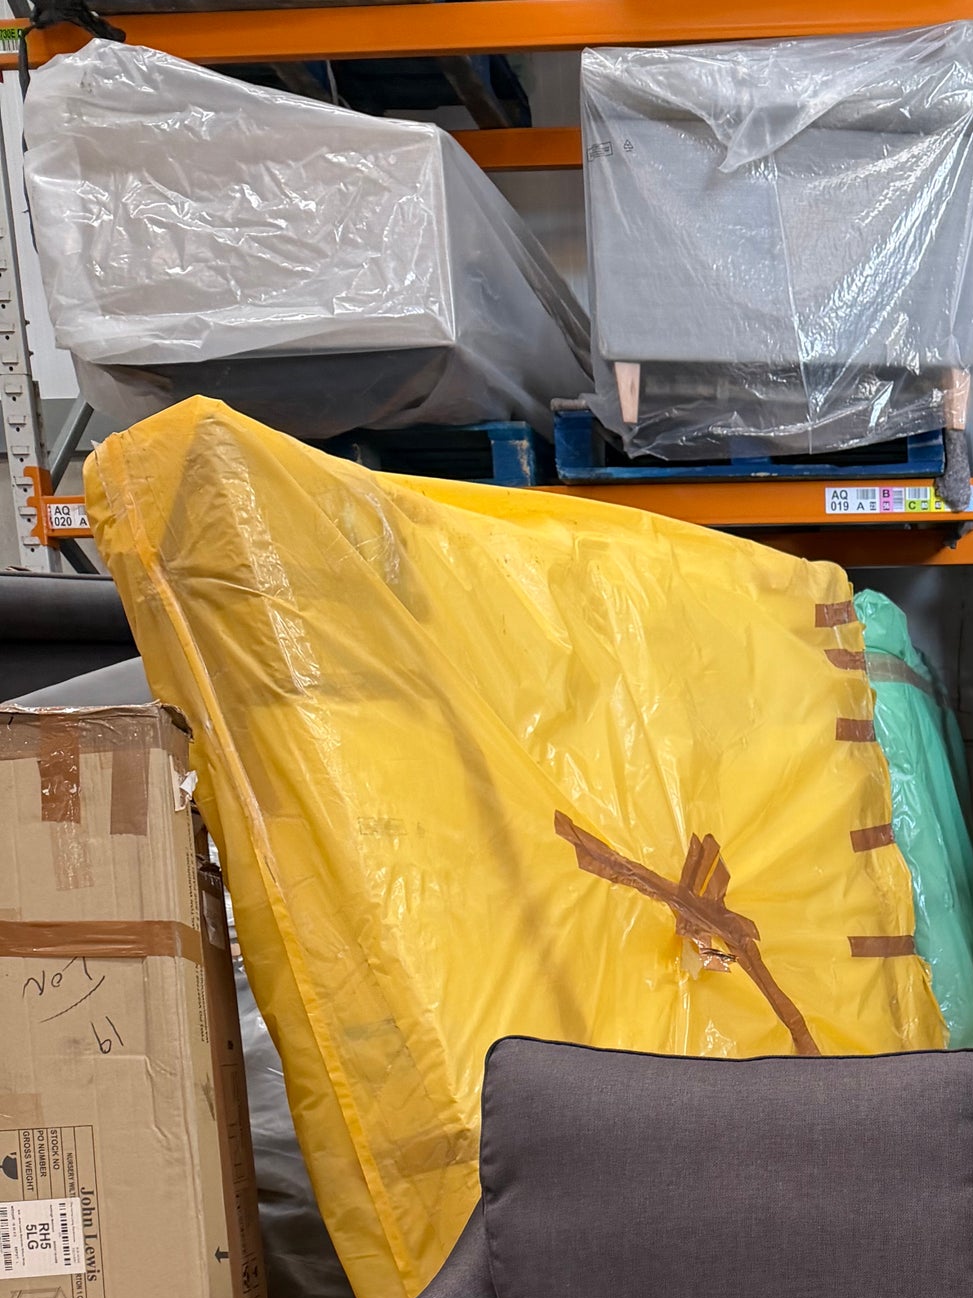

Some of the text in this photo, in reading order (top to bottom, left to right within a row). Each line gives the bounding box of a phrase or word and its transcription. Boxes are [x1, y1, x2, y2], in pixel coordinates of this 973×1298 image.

[831, 490, 848, 500] AQ
[831, 501, 849, 511] 019
[856, 502, 865, 511] A
[882, 489, 890, 498] B
[908, 501, 916, 510] C
[54, 505, 70, 516] AQ
[54, 516, 88, 527] 020 A
[22, 1130, 34, 1192] GROSS WEIGHT
[37, 1130, 47, 1178] PO NUMBER
[50, 1129, 60, 1170] STOCK NO
[66, 1152, 75, 1181] NURSERY
[26, 1224, 39, 1250] 5LG
[38, 1222, 51, 1250] RH5
[80, 1187, 101, 1282] John Lewis
